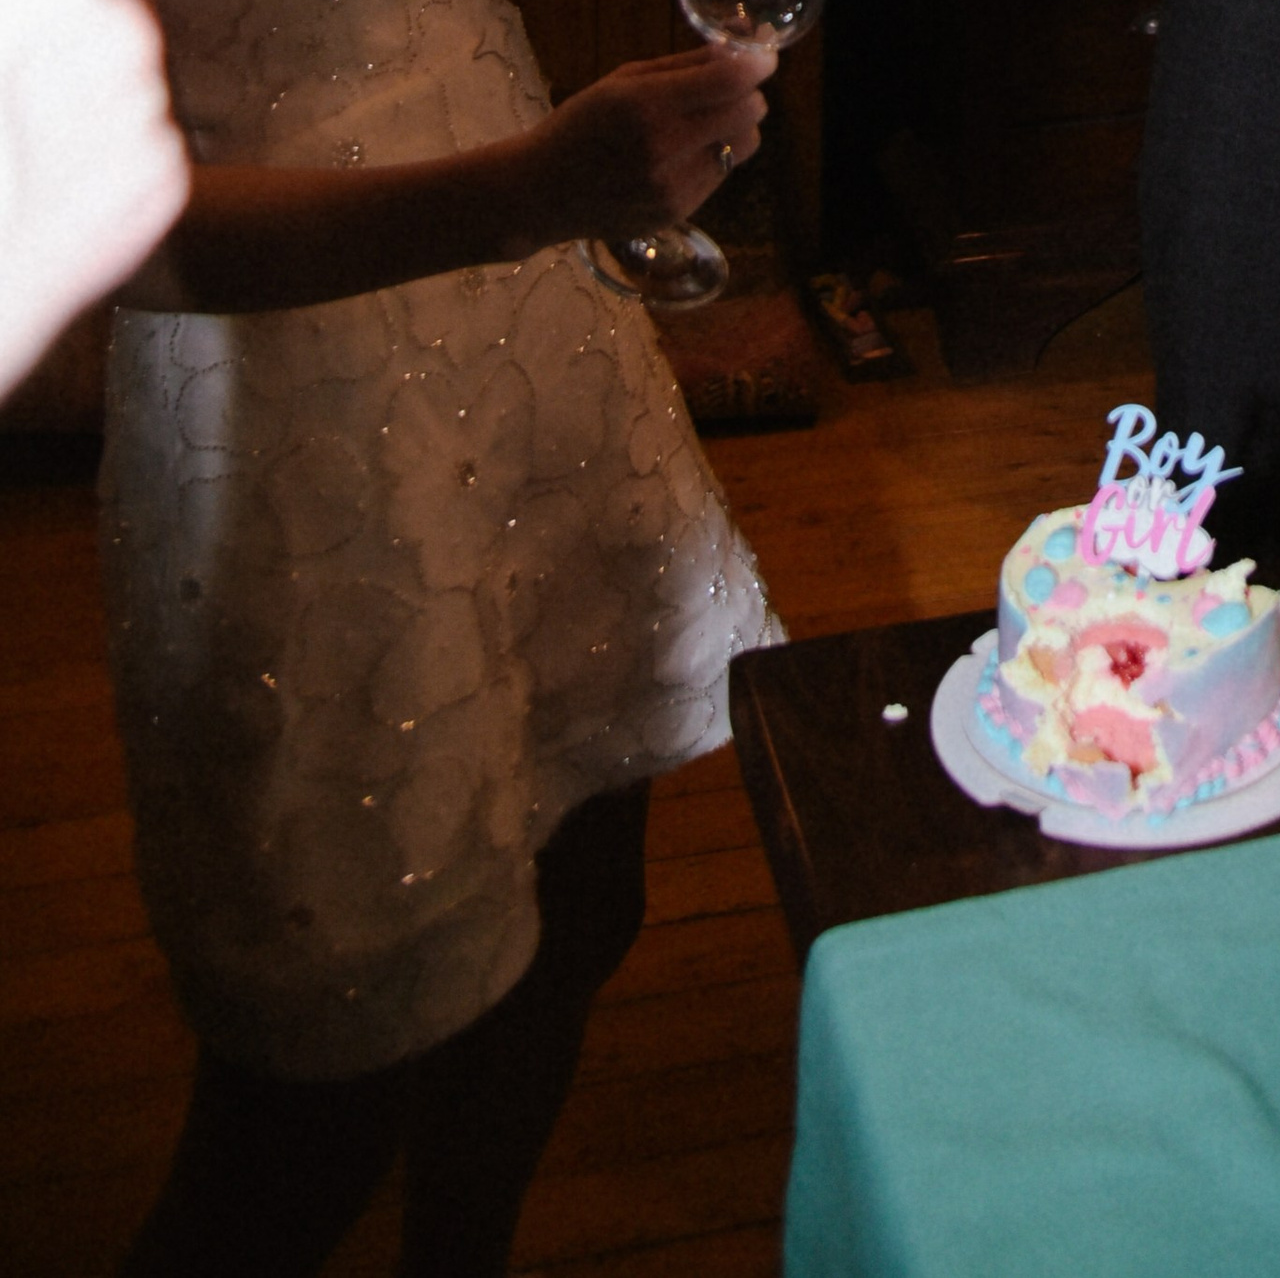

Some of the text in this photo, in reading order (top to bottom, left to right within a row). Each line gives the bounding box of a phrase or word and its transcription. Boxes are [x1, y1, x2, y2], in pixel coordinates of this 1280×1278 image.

[1099, 404, 1245, 514] Boy
[1127, 474, 1179, 511] or
[1081, 482, 1217, 574] Girl
